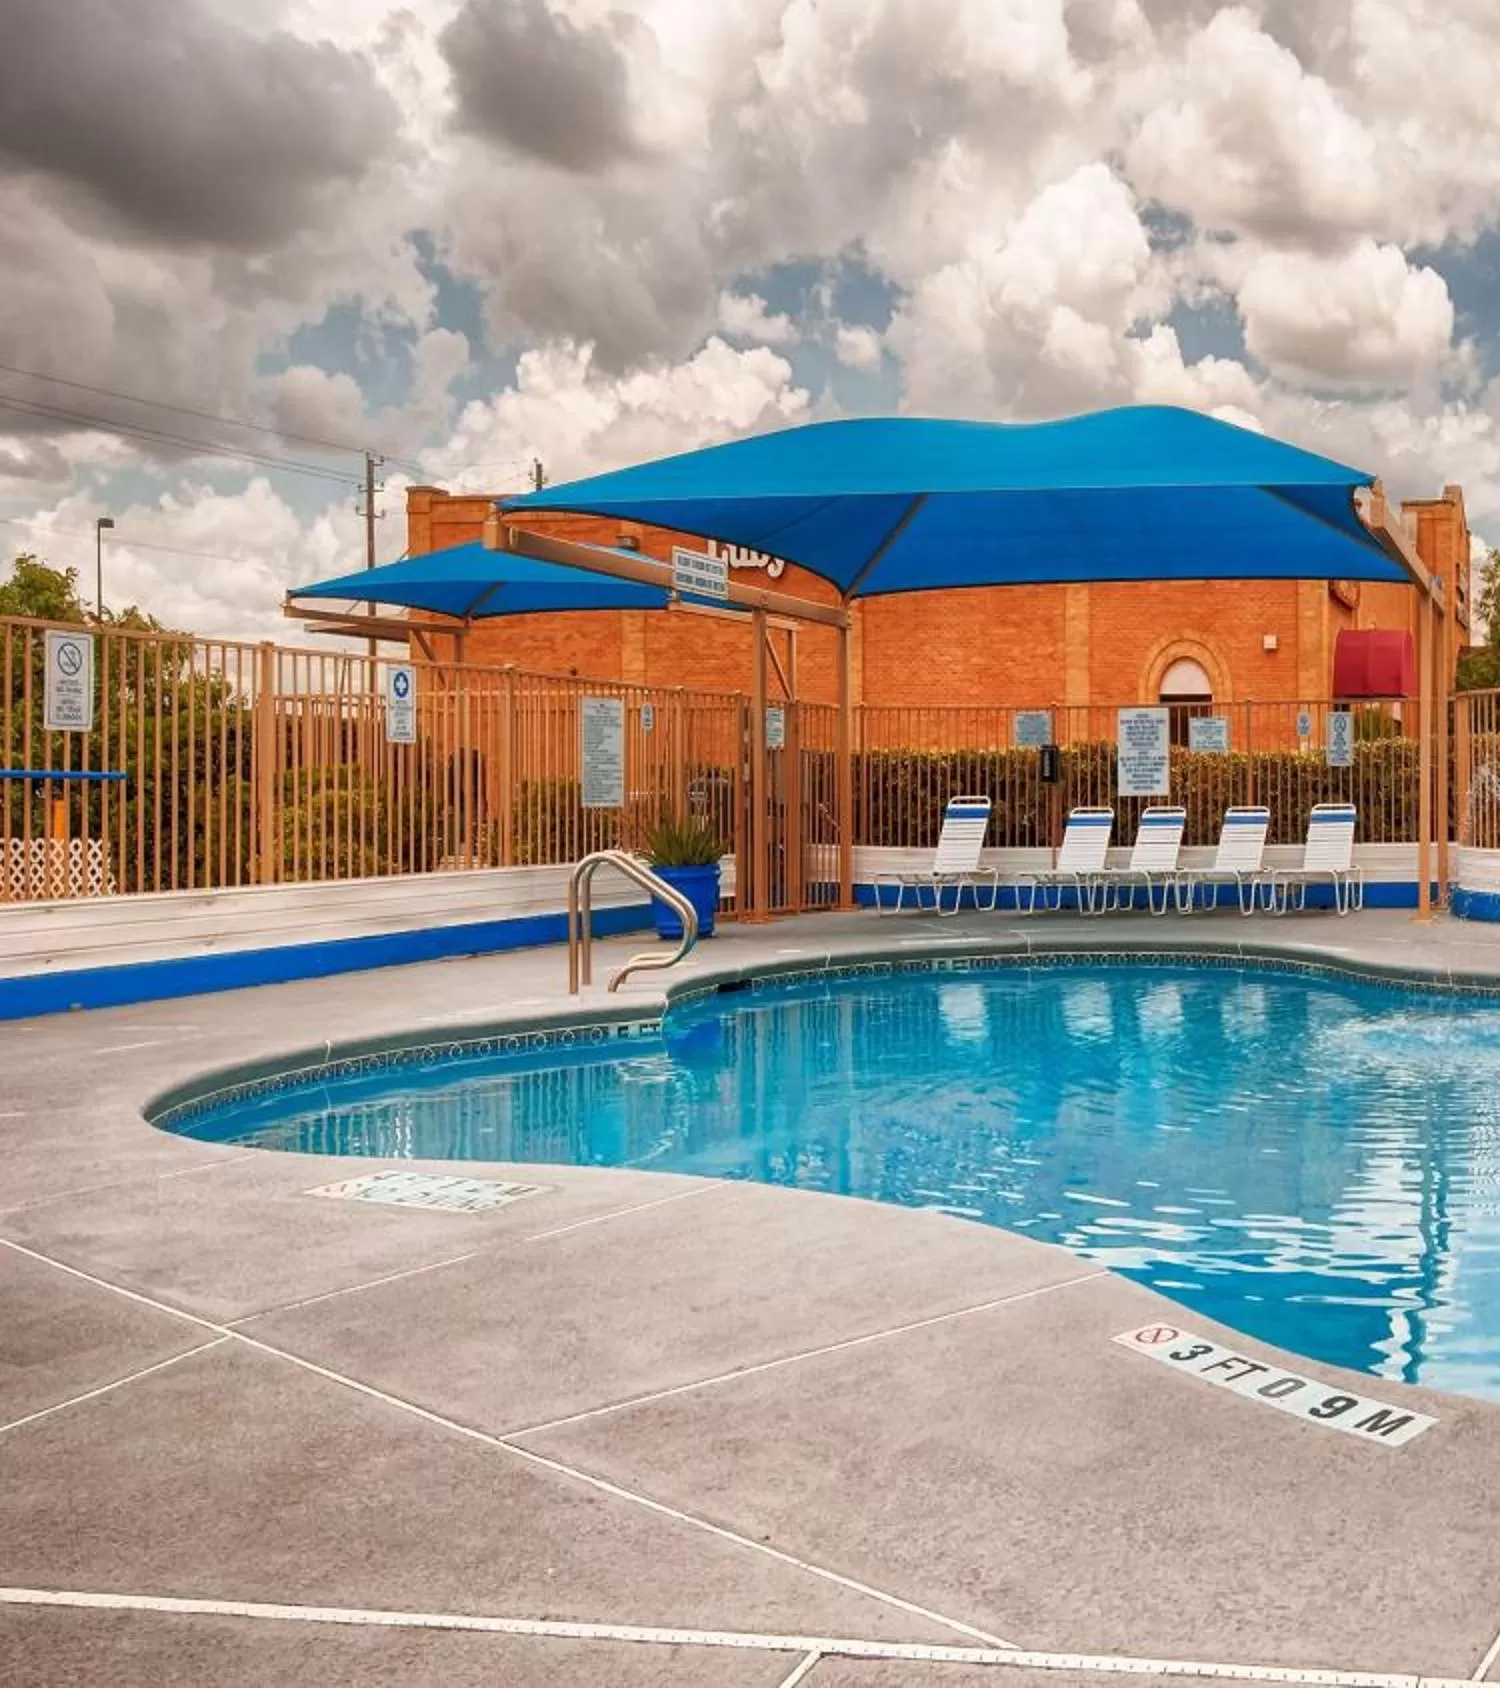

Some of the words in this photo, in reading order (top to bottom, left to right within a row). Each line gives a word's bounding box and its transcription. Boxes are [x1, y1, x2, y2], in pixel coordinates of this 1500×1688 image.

[1169, 1344, 1214, 1362] 3
[1199, 1357, 1269, 1382] FT
[1353, 1409, 1416, 1437] M
